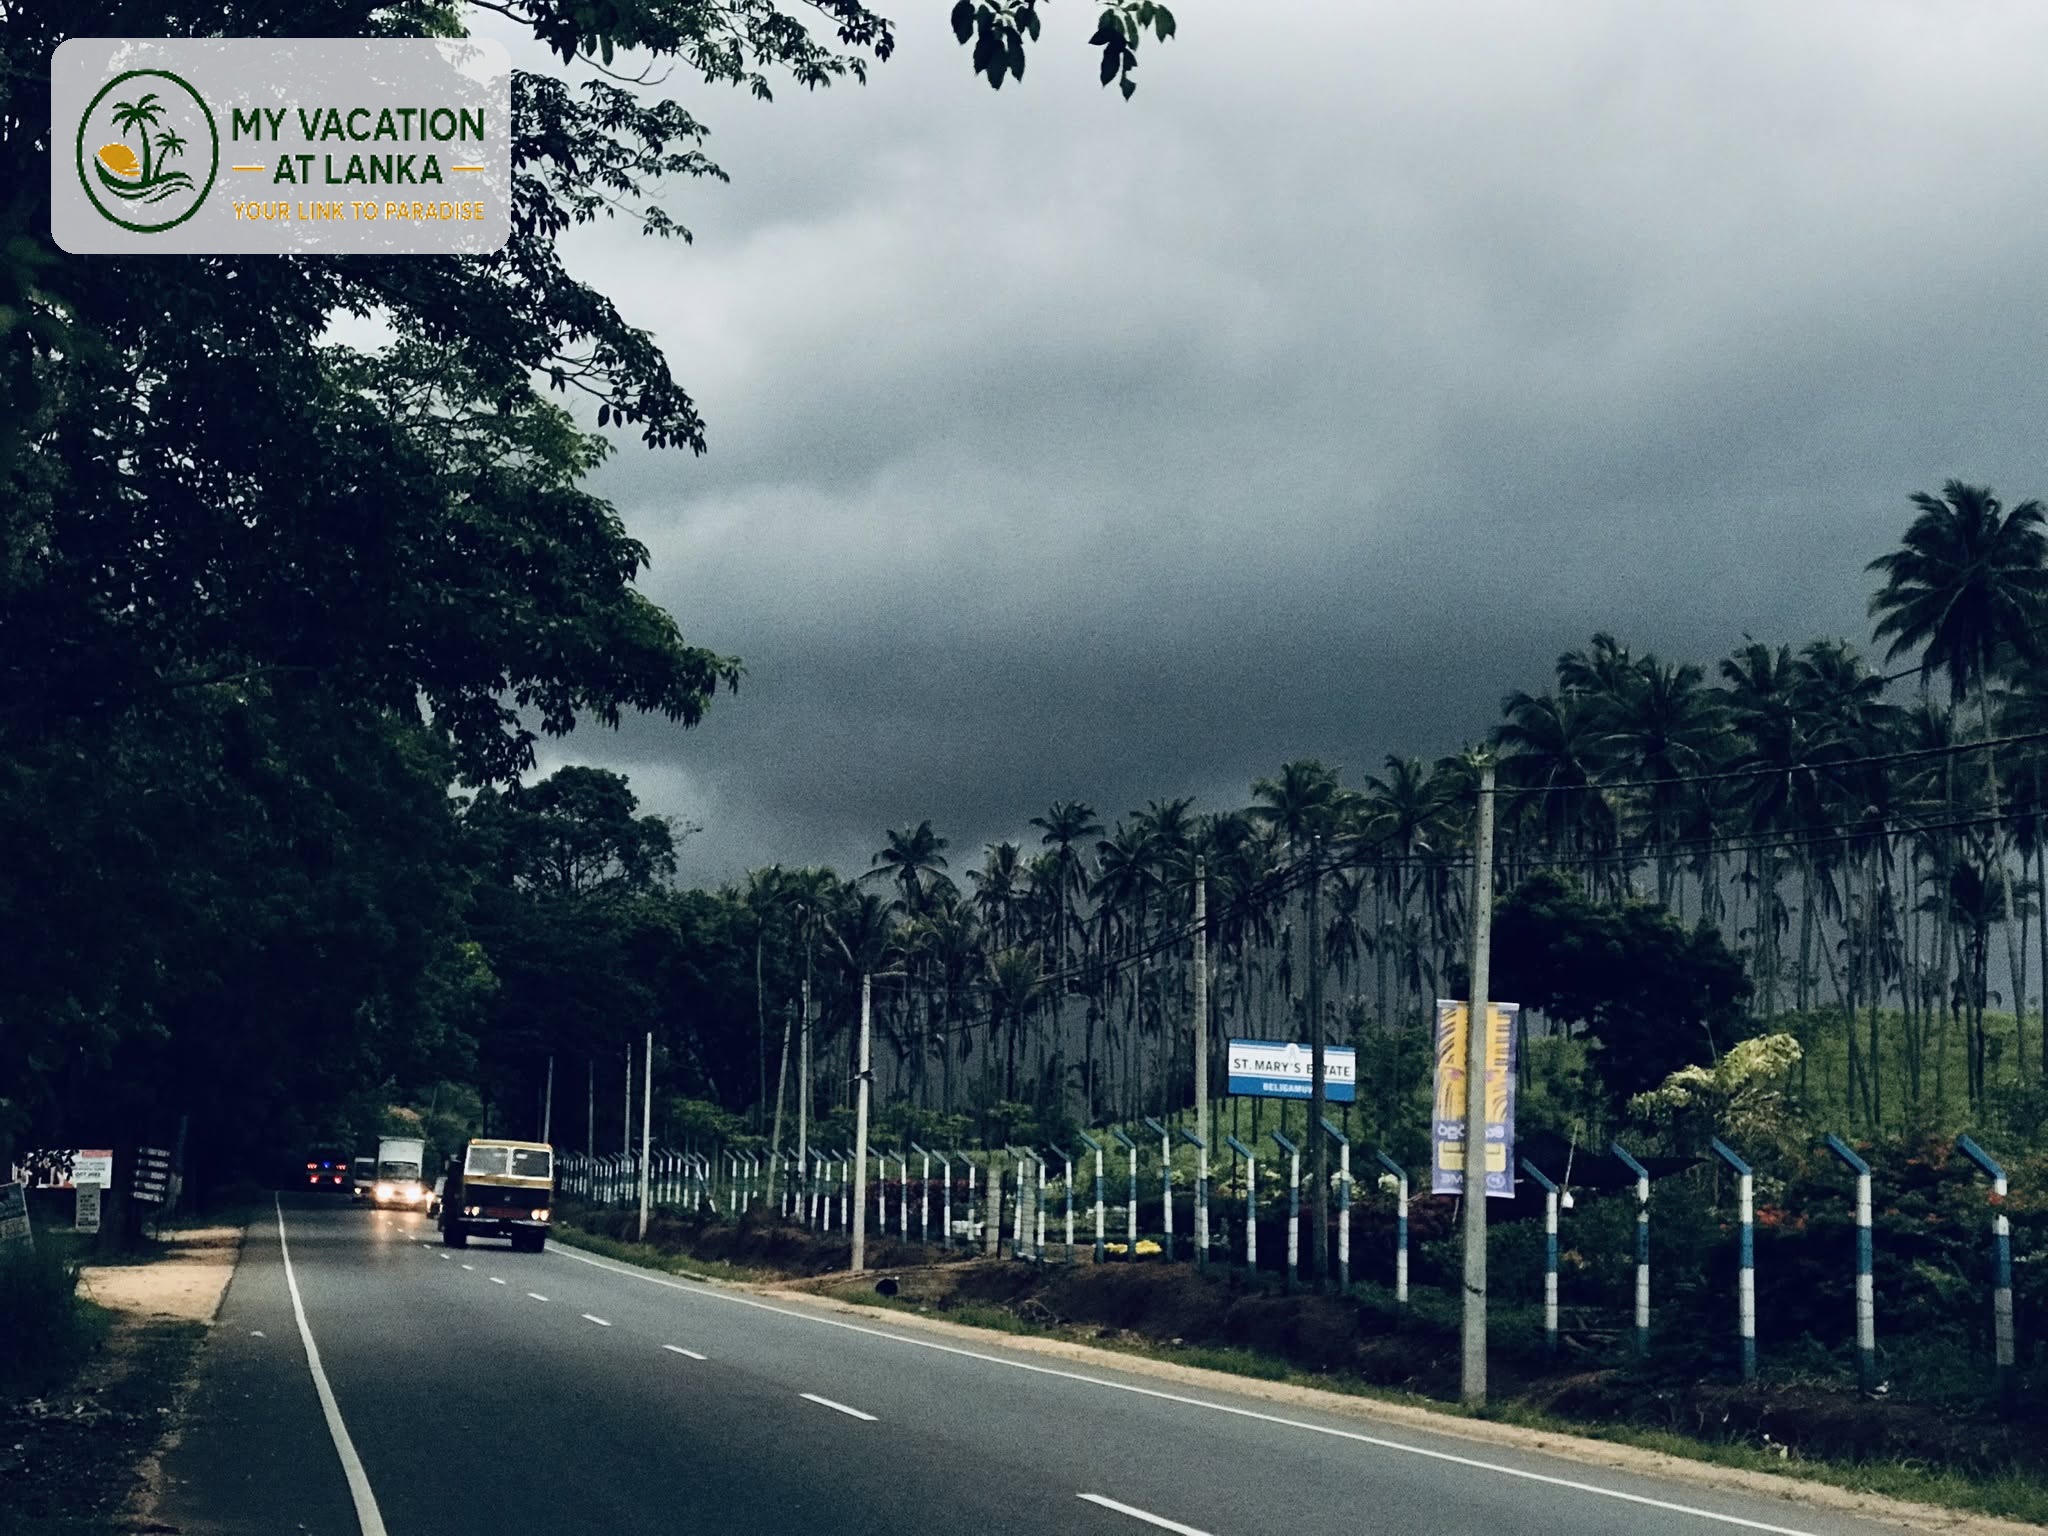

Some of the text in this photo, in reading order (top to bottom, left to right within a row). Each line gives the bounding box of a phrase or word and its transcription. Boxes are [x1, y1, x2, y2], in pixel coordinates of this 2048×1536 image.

[1233, 1058, 1351, 1077] ST. MARY'S ETATE
